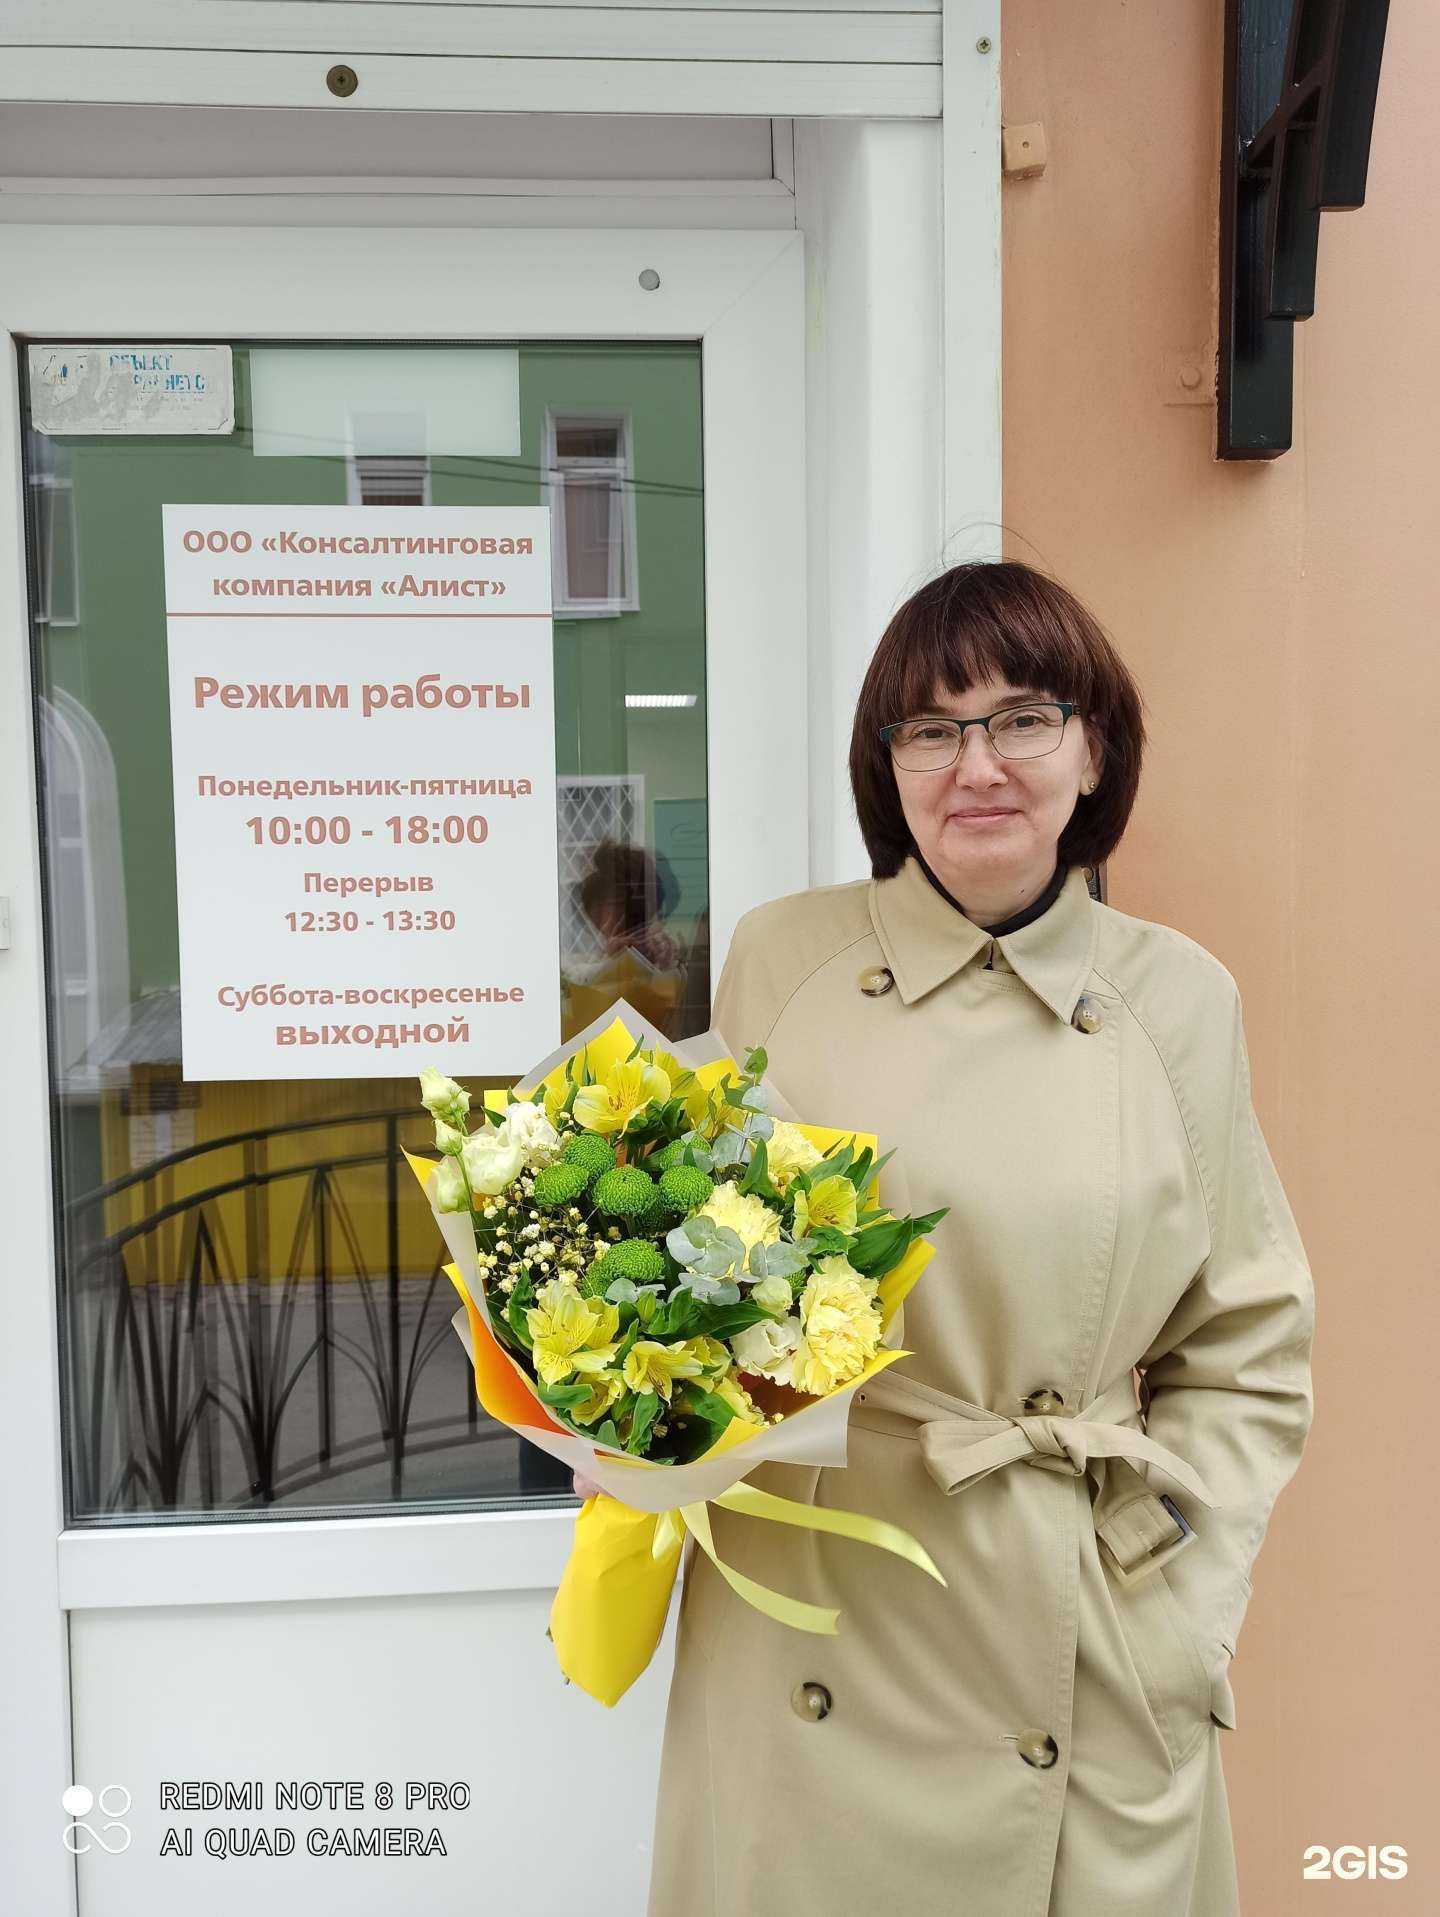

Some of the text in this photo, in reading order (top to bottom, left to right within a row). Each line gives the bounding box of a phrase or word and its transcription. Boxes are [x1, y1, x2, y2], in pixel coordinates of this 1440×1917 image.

[182, 530, 534, 556] ООО «Консалтинговая
[213, 574, 506, 599] компания «Алист»
[194, 673, 531, 718] Режим работы
[198, 775, 533, 801] Понедельник-пятница
[246, 815, 351, 846] 10:00
[384, 815, 490, 845] 18:00
[303, 872, 435, 898] Перерыв
[284, 911, 359, 933] 12:30
[382, 910, 456, 931] 13:30
[217, 983, 525, 1012] Суббота-воскресенье
[276, 1015, 471, 1049] выходной
